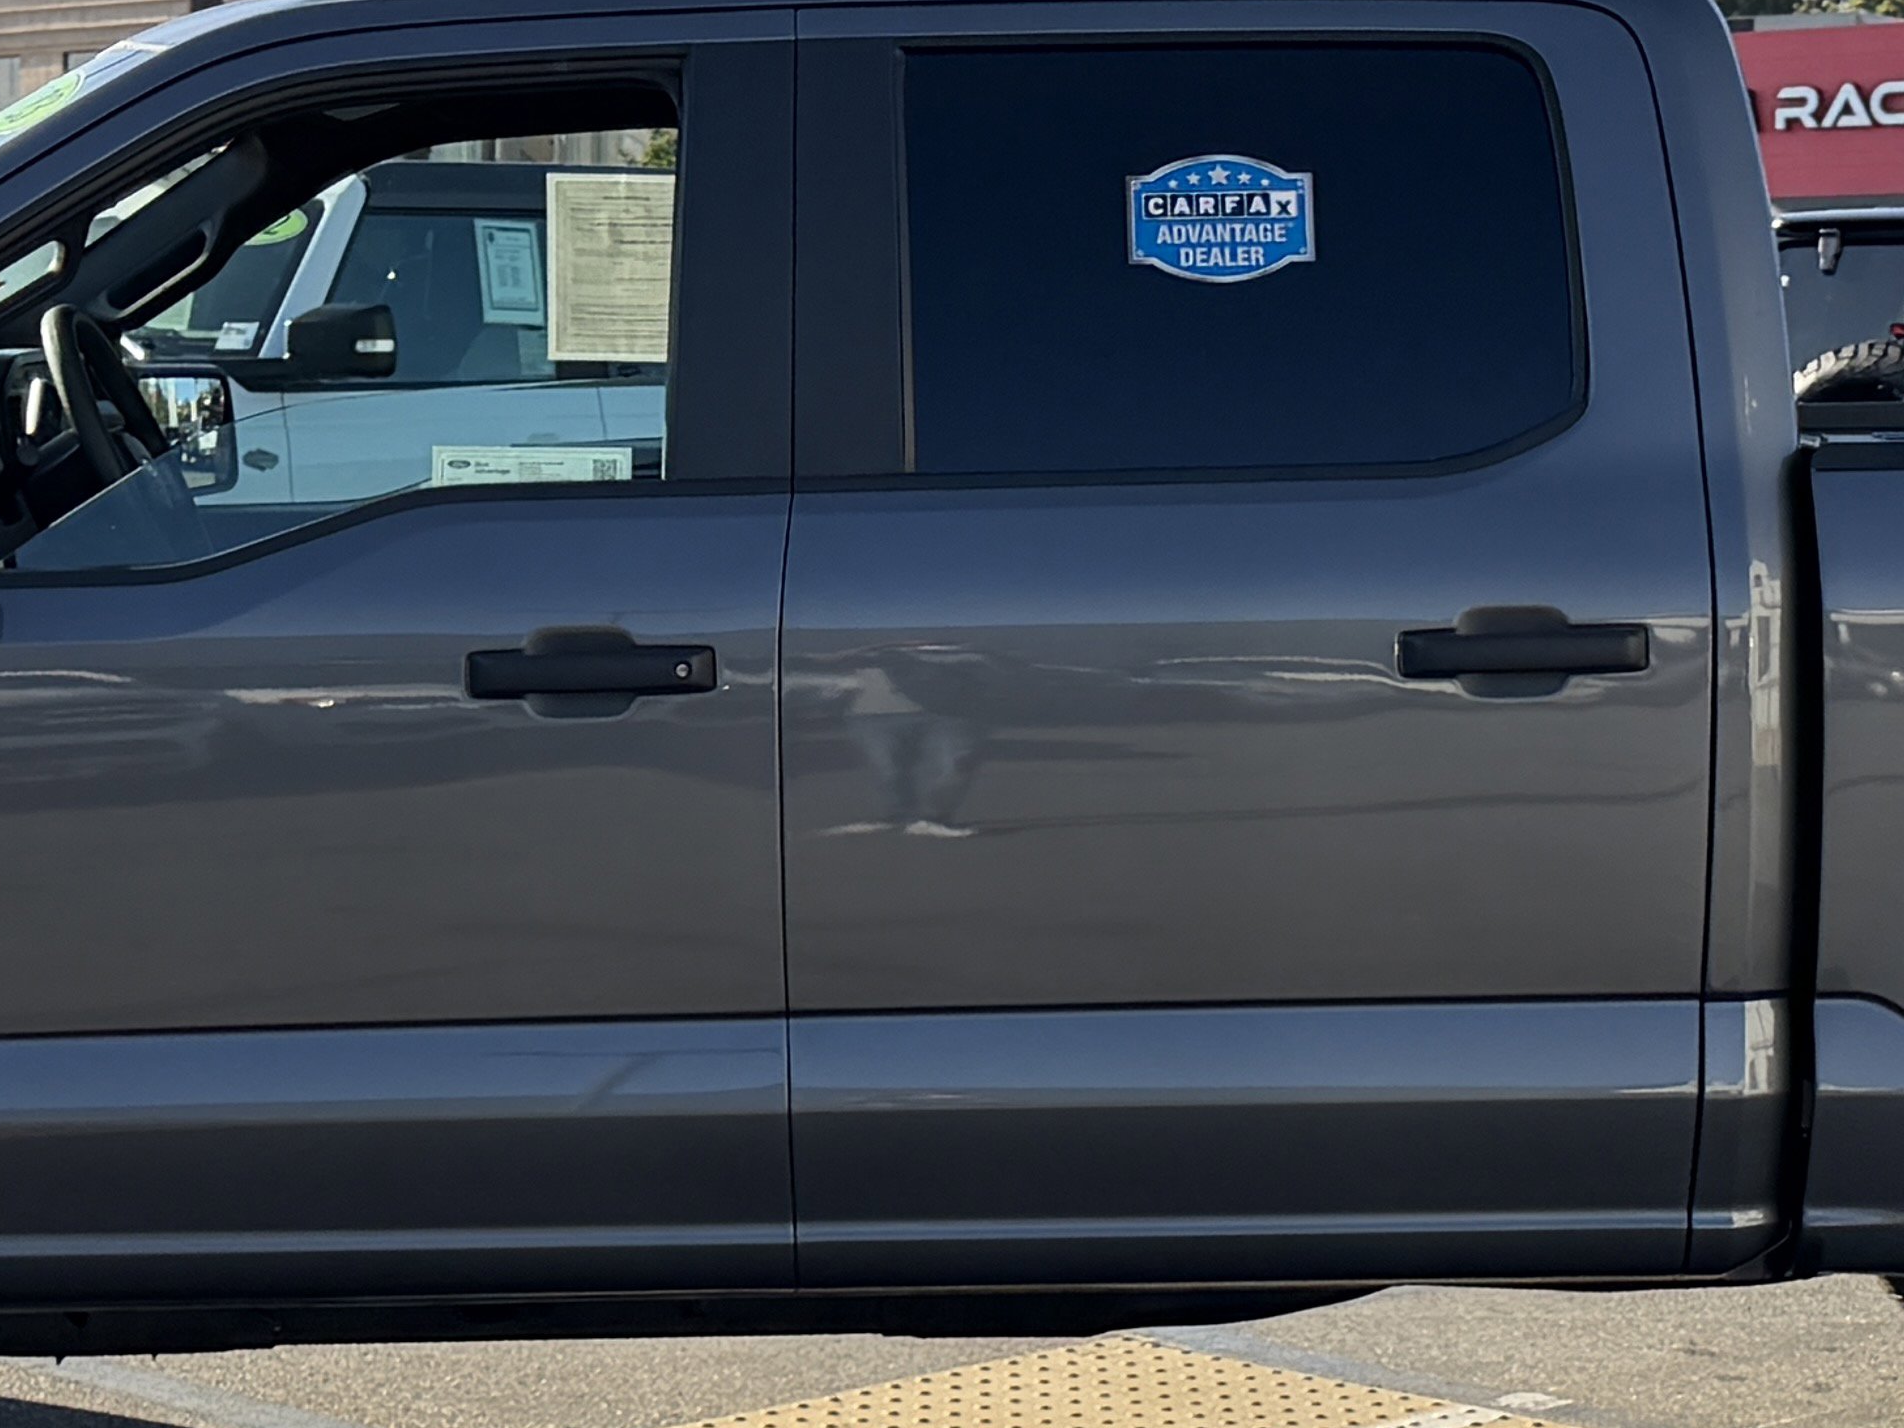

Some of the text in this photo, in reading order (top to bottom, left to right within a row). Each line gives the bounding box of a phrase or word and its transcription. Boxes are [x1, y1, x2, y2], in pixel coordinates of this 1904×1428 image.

[1146, 194, 1295, 217] CARFAX
[1157, 223, 1287, 245] ADVANTAGE
[1179, 247, 1265, 267] DEALER
